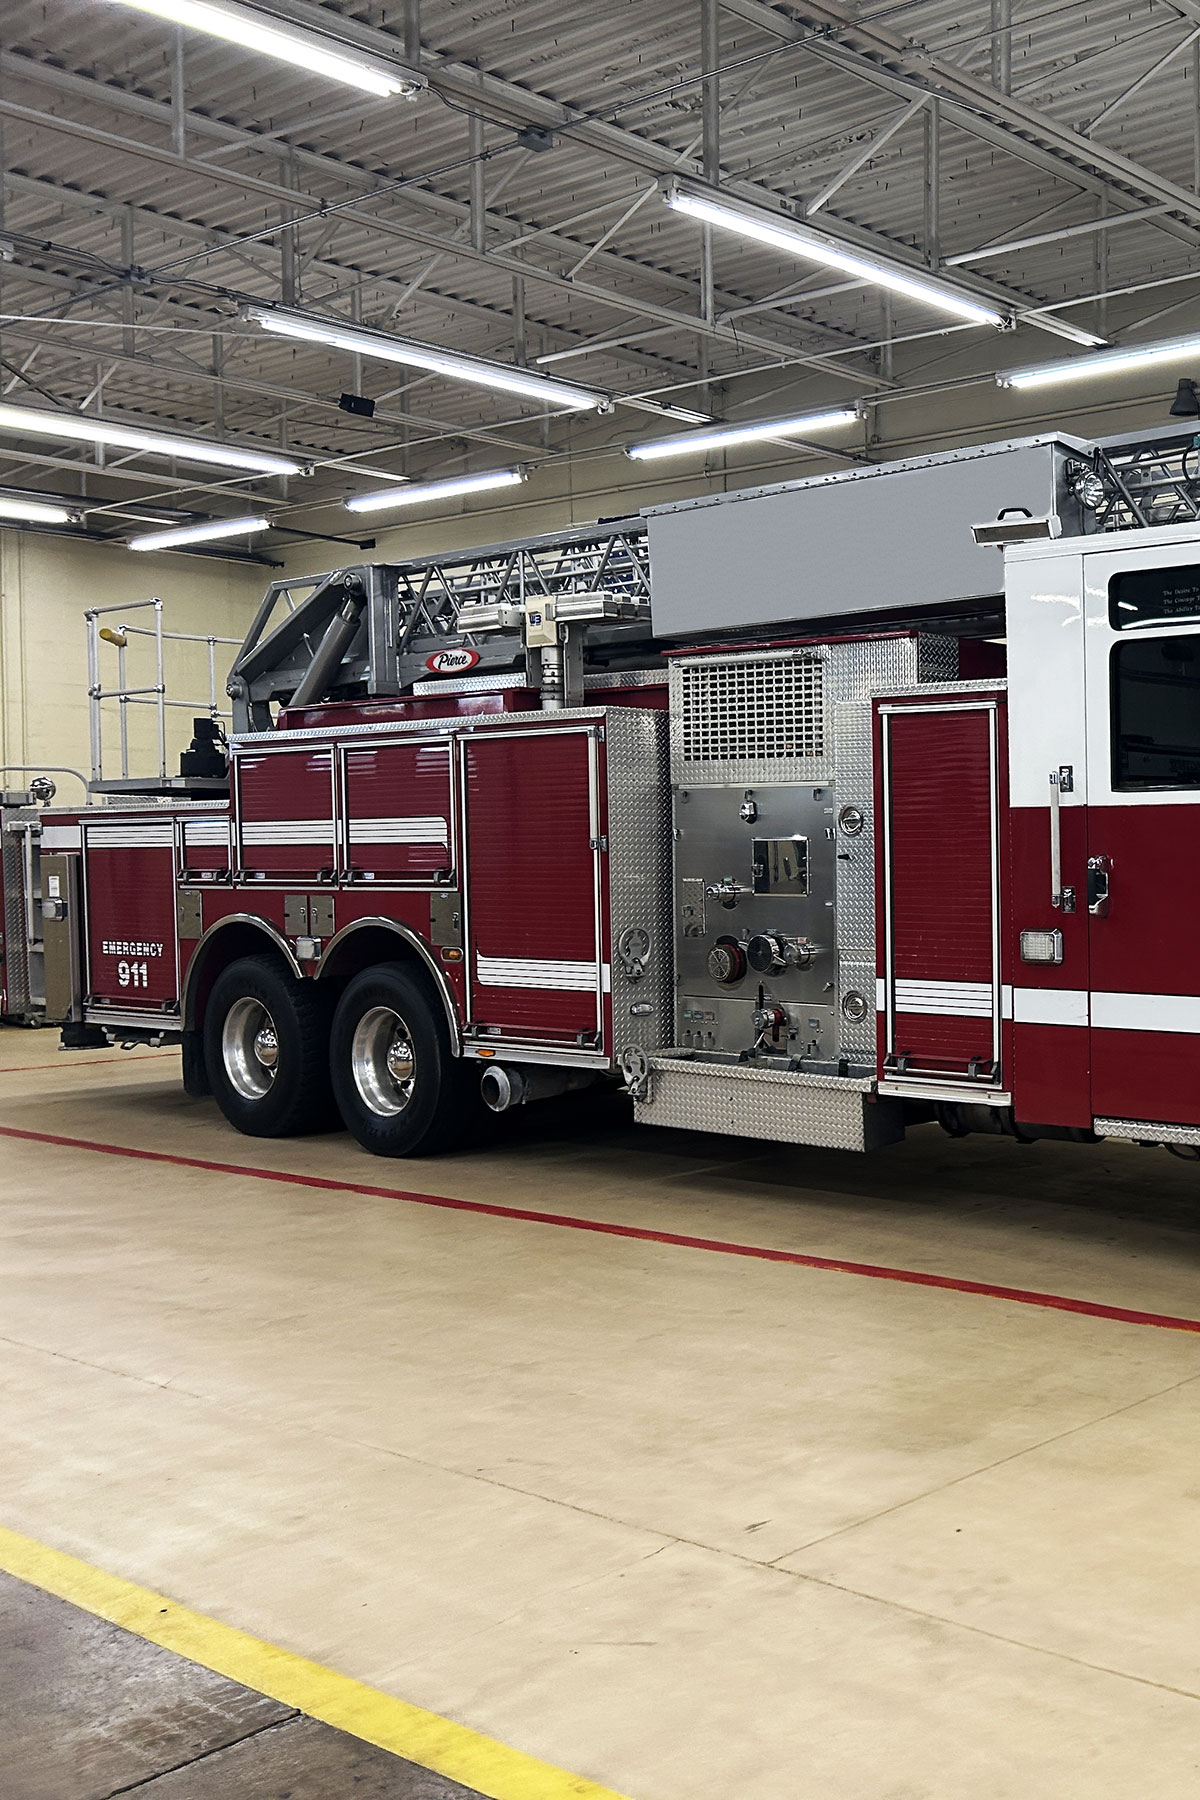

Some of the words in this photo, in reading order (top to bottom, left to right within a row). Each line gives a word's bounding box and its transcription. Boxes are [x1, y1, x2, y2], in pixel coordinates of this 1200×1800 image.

[1176, 605, 1194, 613] Ability
[438, 653, 468, 670] Pierce
[102, 941, 163, 957] EMERGENCY
[118, 960, 148, 988] 911
